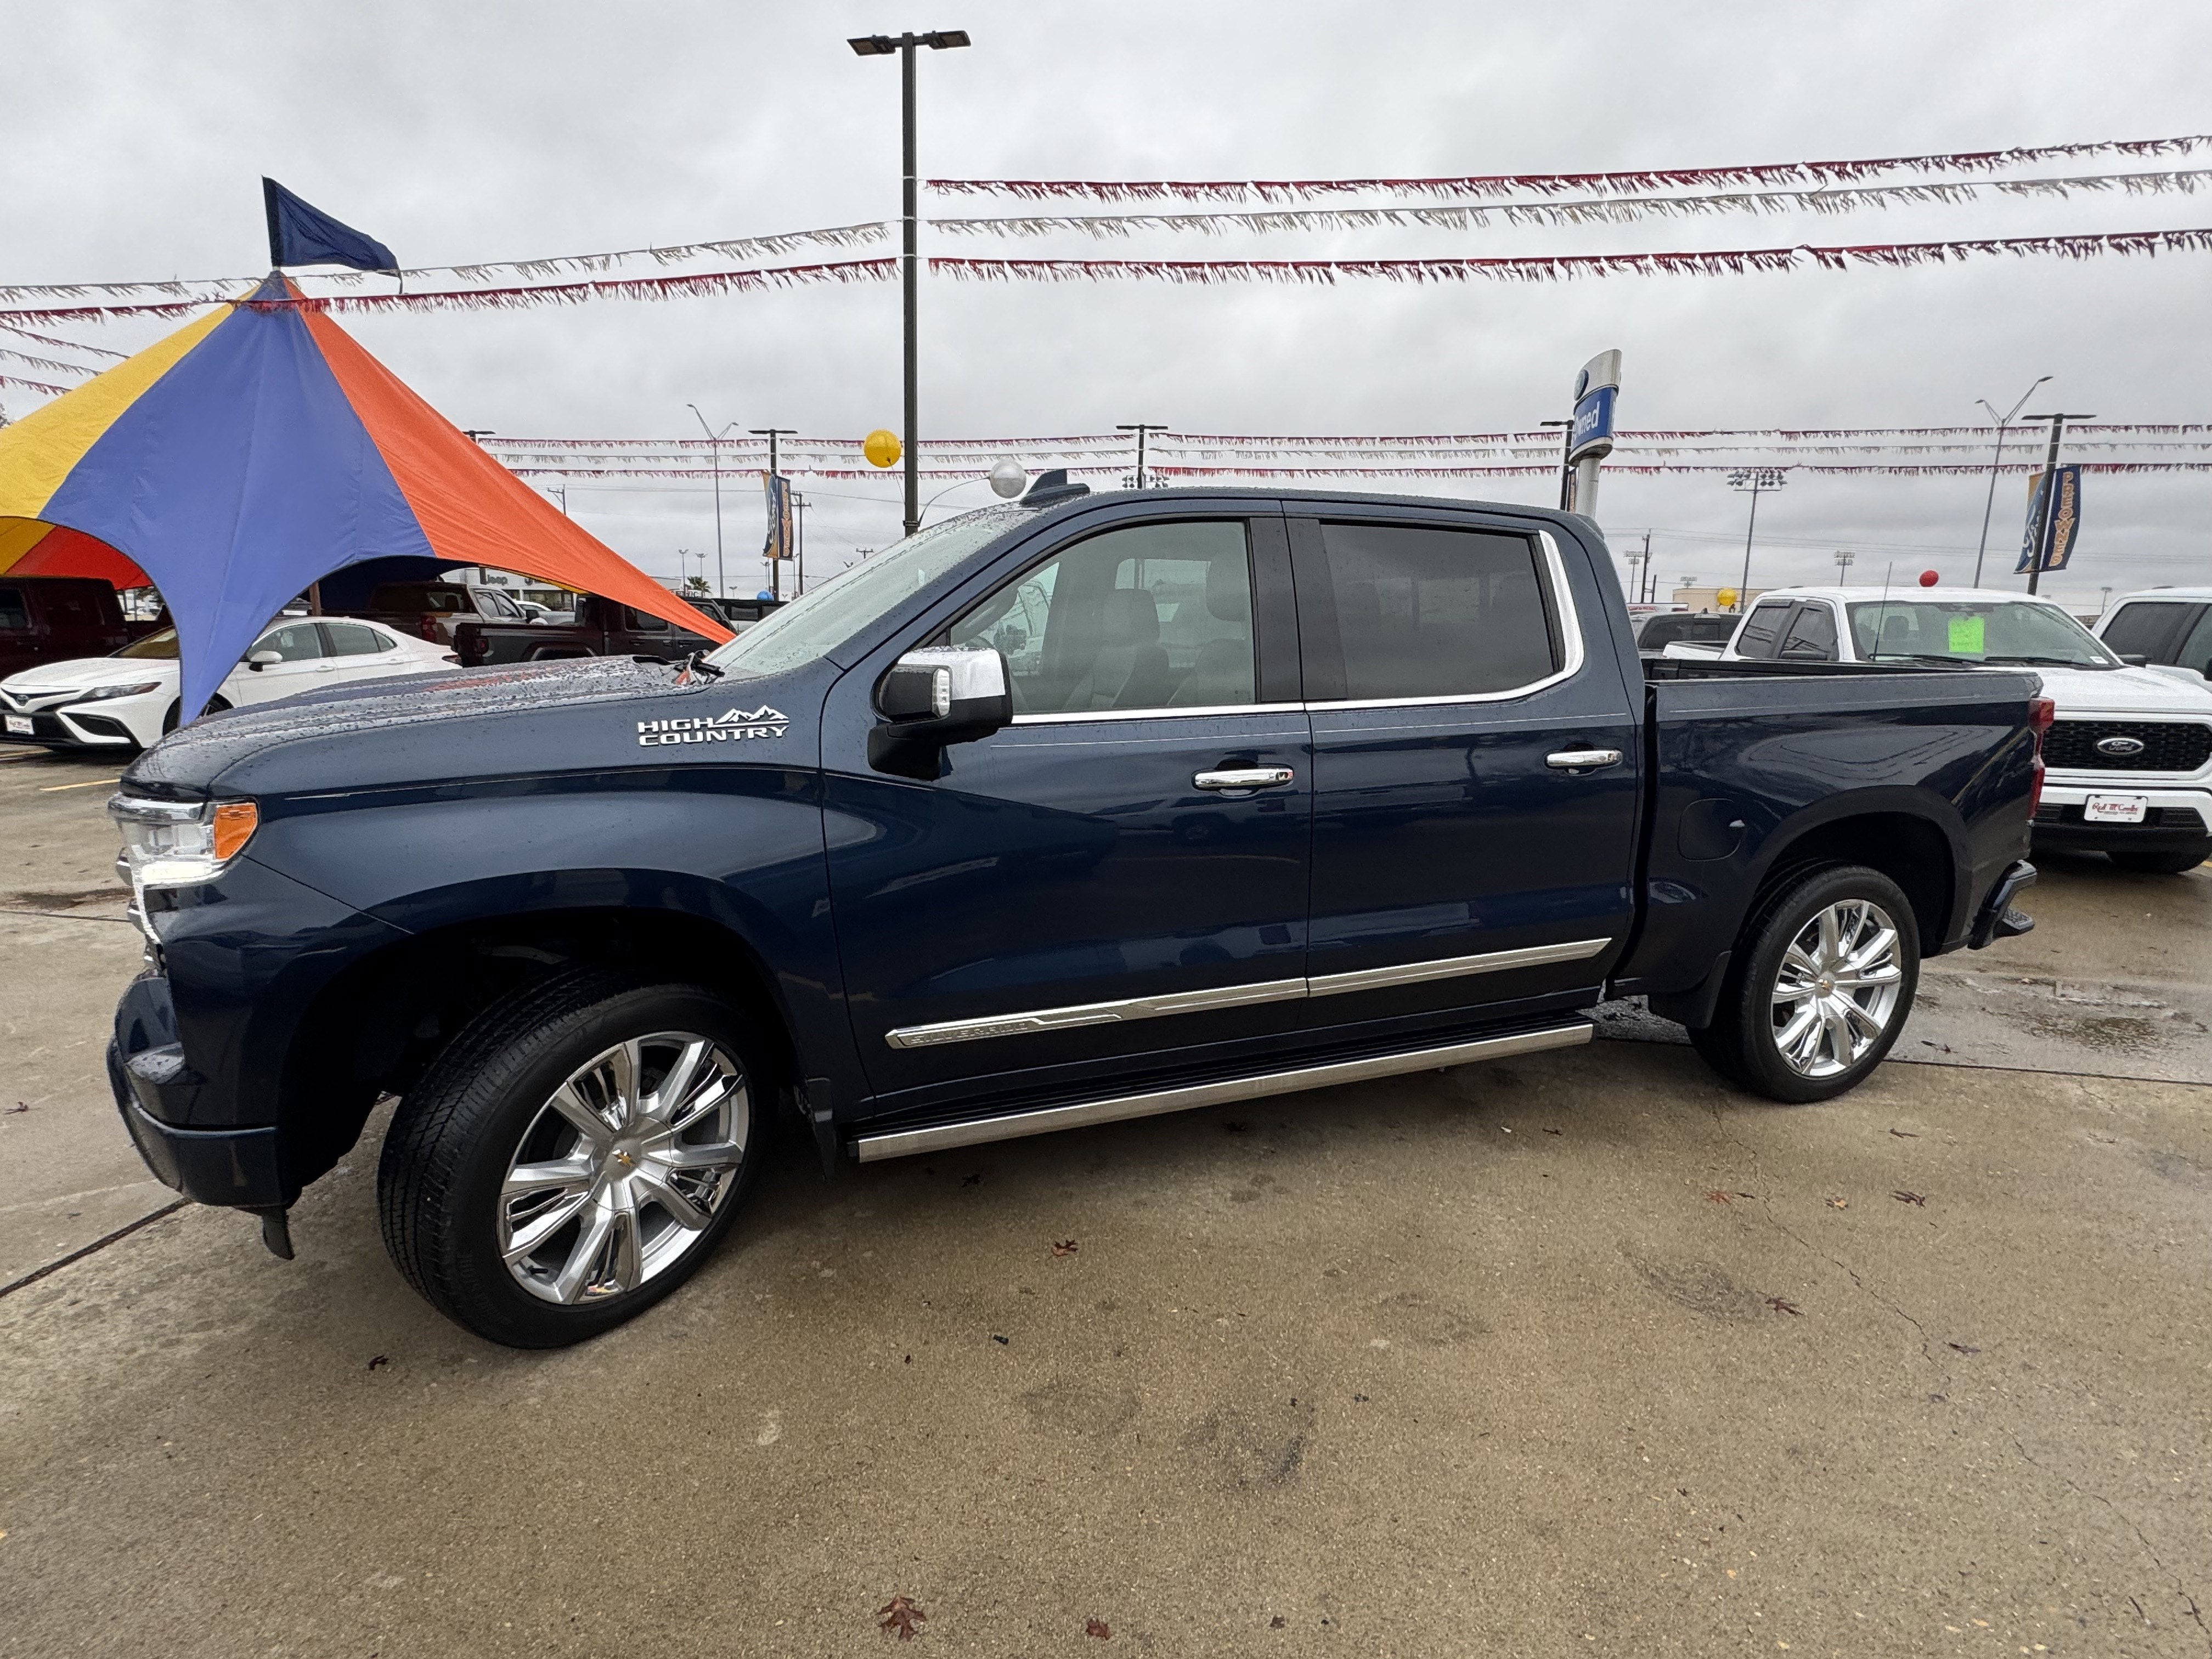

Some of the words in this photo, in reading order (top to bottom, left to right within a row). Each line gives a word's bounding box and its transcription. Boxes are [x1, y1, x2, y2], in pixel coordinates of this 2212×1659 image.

[637, 717, 714, 733] HIGH
[639, 726, 789, 746] COUNTRY
[2108, 741, 2135, 751] Ford
